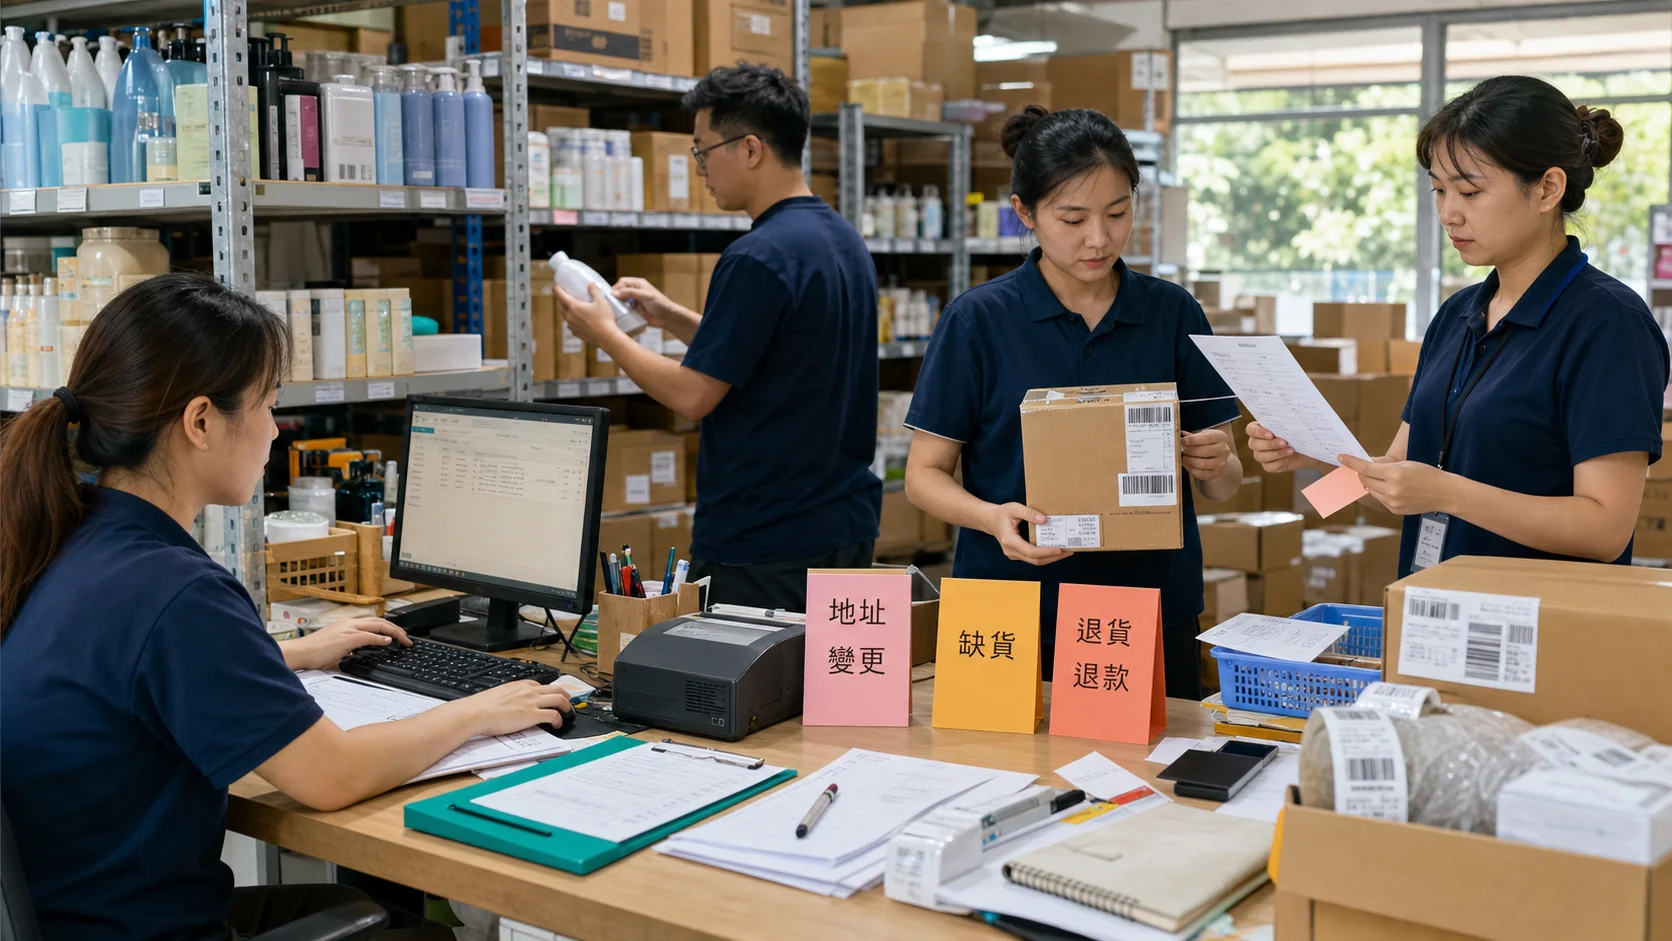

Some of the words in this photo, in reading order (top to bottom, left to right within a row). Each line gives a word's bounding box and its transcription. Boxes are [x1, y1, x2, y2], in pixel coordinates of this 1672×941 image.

[828, 597, 886, 626] 地址
[958, 629, 1016, 661] 缺貨
[1076, 617, 1132, 648] 退貨
[828, 646, 885, 675] 變更
[1073, 662, 1129, 692] 退款
